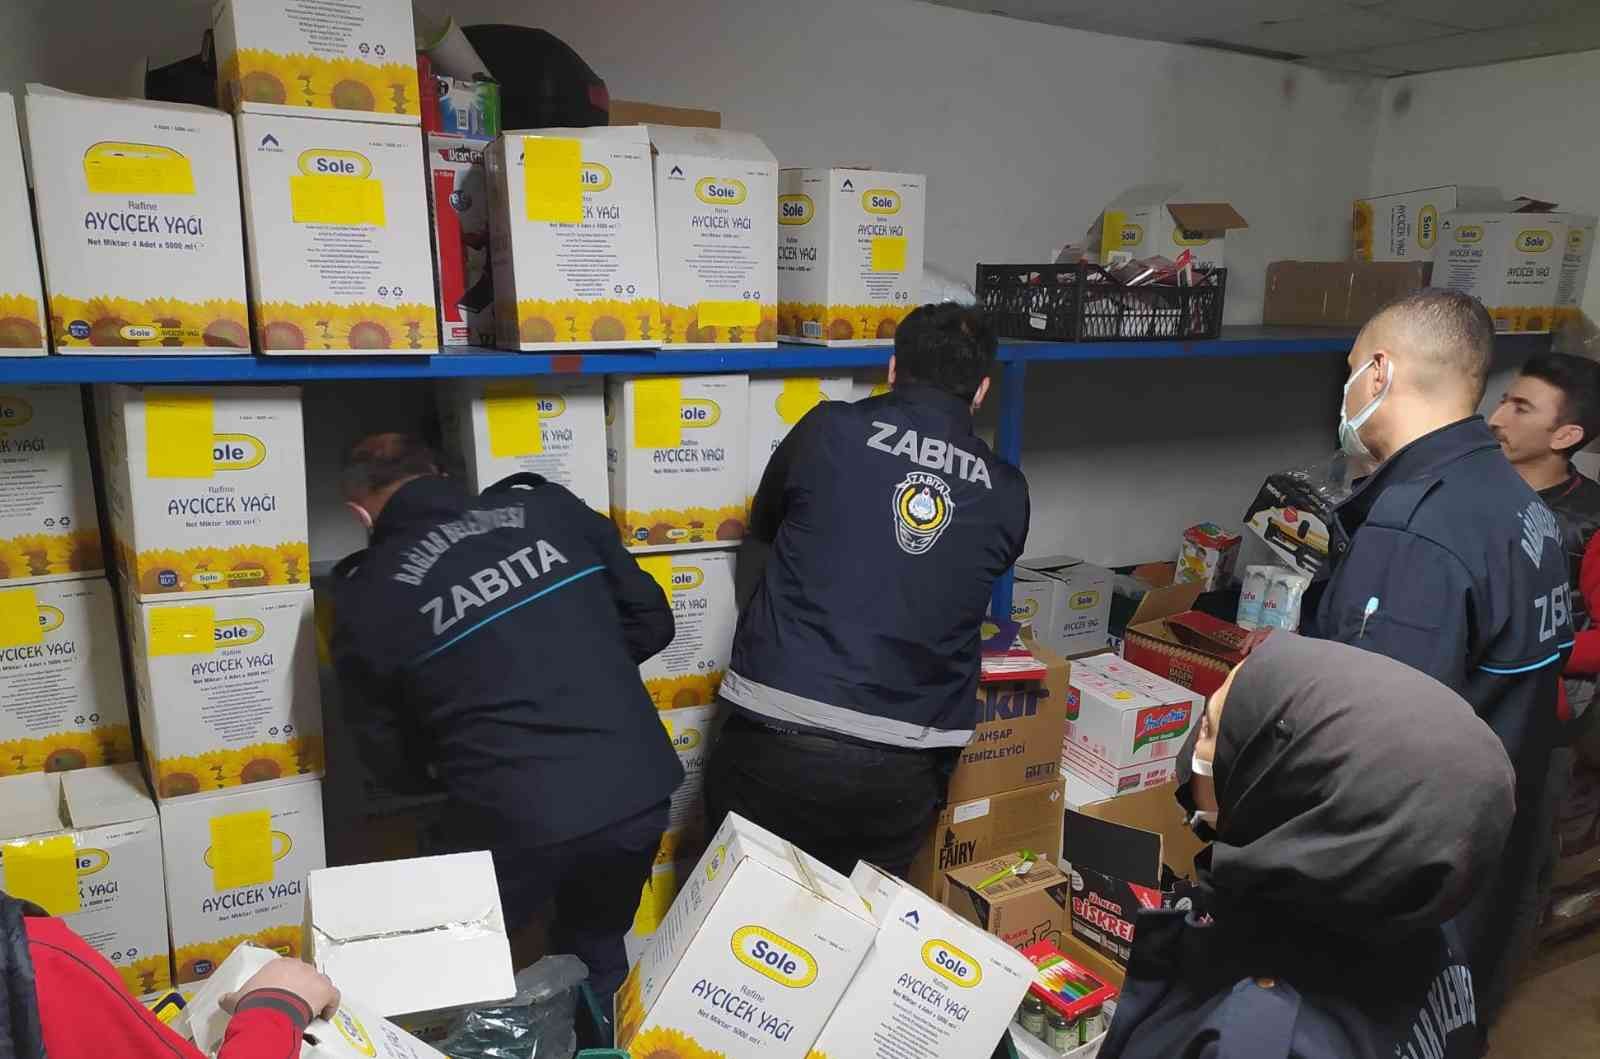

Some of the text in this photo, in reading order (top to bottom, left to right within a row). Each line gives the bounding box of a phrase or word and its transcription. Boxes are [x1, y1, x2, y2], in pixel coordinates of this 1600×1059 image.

[316, 157, 355, 174] Sole
[581, 172, 598, 185] le
[708, 184, 735, 198] Sole
[872, 196, 892, 208] Sole
[783, 203, 804, 217] Sole
[1423, 215, 1432, 240] Sole
[87, 238, 101, 247] Net
[1524, 236, 1545, 247] Sole
[537, 400, 553, 411] le
[679, 406, 706, 420] ole
[213, 444, 244, 461] ole
[866, 420, 993, 490] ZABITA
[911, 475, 946, 493] ZABITA
[672, 573, 692, 584] ole
[418, 538, 569, 636] ZABITA
[214, 626, 248, 641] Sole
[672, 735, 689, 746] ole
[977, 728, 1013, 743] AHŞAP
[75, 857, 91, 869] le
[751, 939, 797, 975] Sole
[935, 950, 968, 977] Sole
